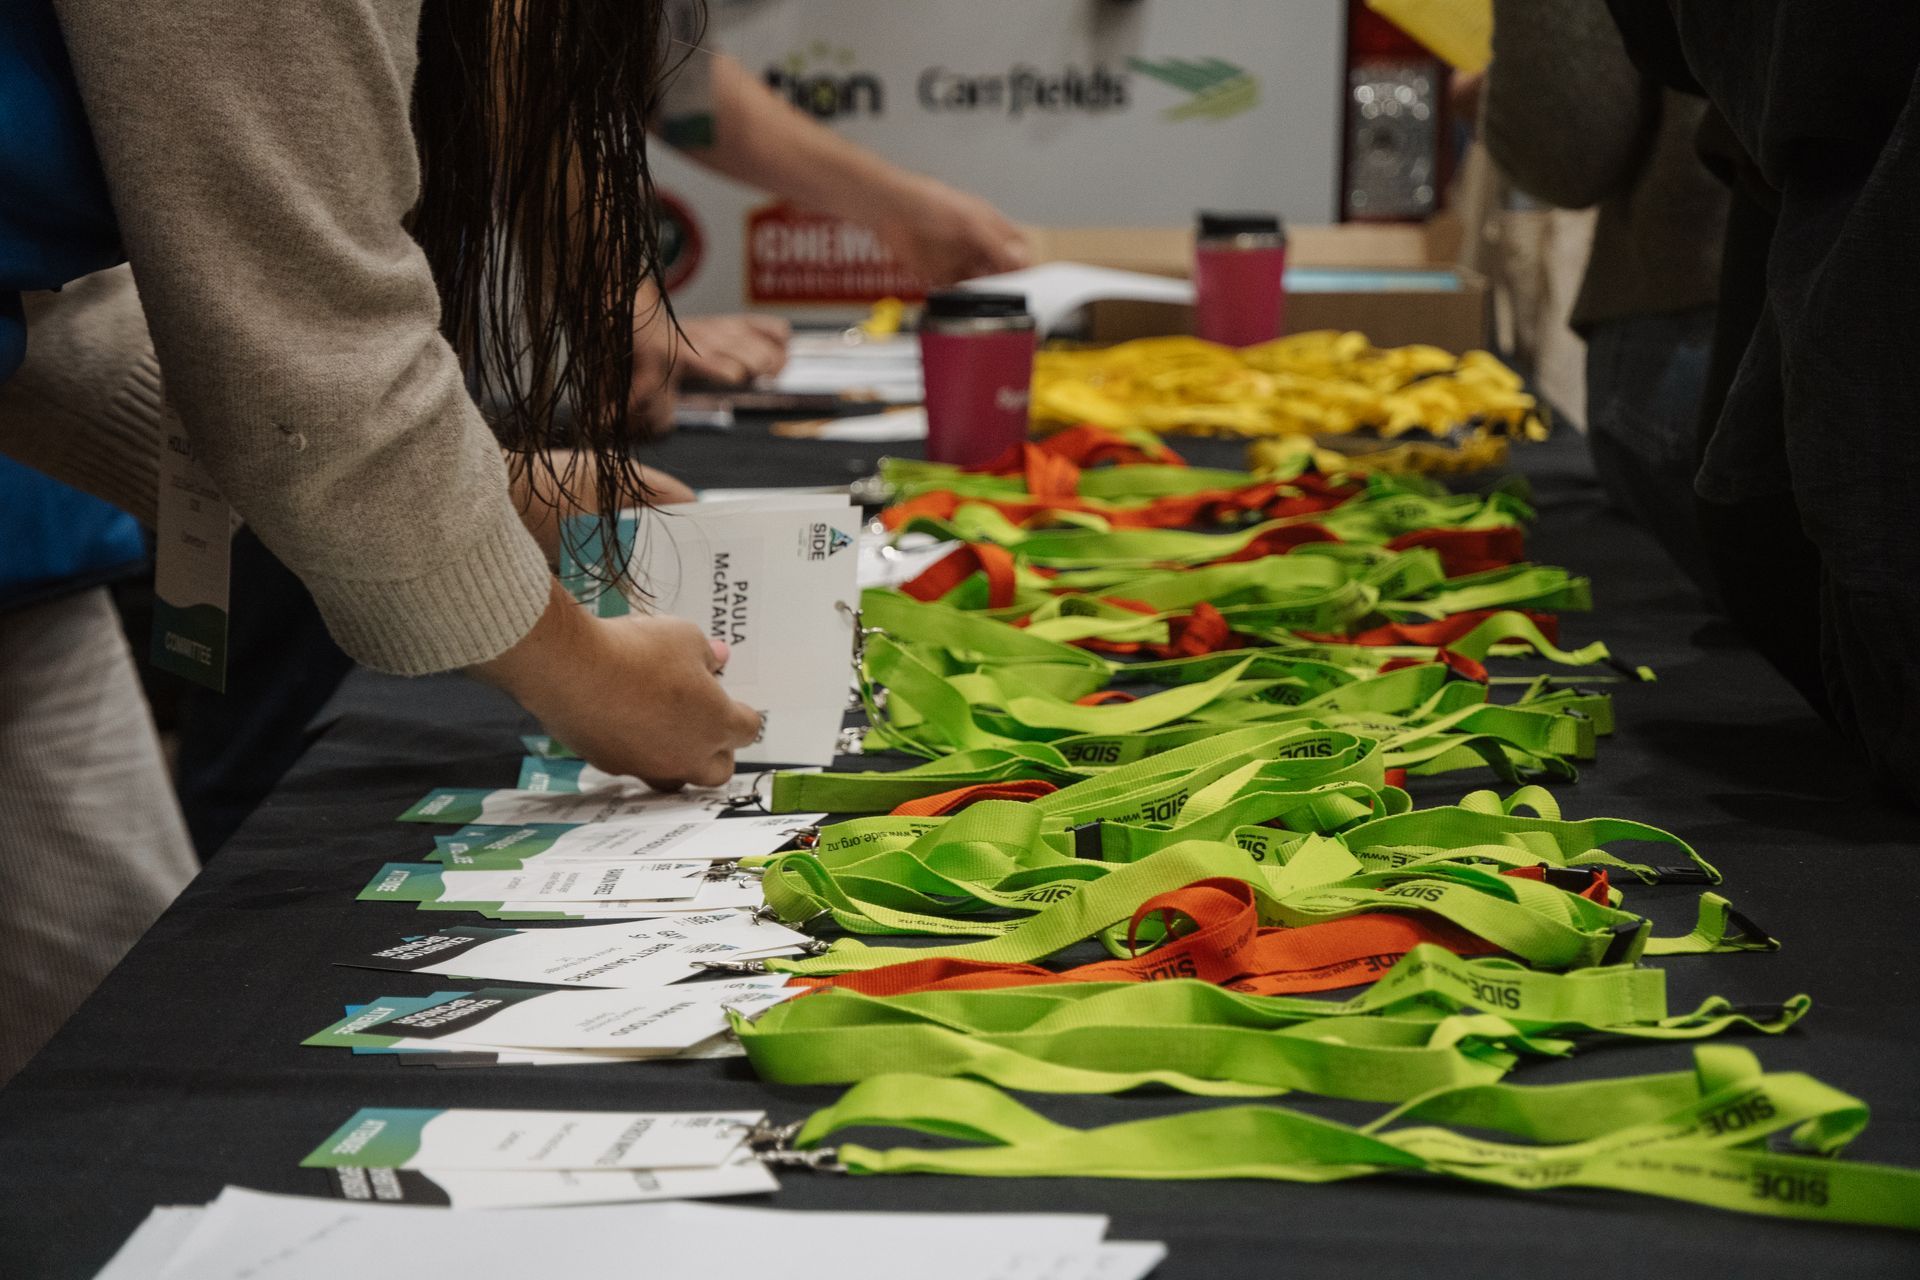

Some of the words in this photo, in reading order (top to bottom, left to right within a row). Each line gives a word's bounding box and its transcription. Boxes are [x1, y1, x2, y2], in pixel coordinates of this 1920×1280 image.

[754, 222, 892, 264] CHEM
[812, 523, 826, 560] SIDE
[730, 580, 749, 646] PAULA
[1069, 745, 1121, 763] SIDE
[826, 829, 911, 851] www.side.org.nz
[594, 883, 616, 896] PEREZ
[371, 935, 450, 957] SPONSOR
[391, 936, 476, 960] EXHIBITOR
[630, 943, 675, 959] BRETT
[563, 957, 637, 982] SAUNDERS
[392, 998, 476, 1025] SPONSOR
[411, 999, 503, 1027] EXHIBITOR
[610, 1018, 659, 1037] TODD
[1703, 1096, 1777, 1137] SIDE
[332, 1119, 388, 1155] ATTENDEE
[1751, 1171, 1830, 1207] SIDE
